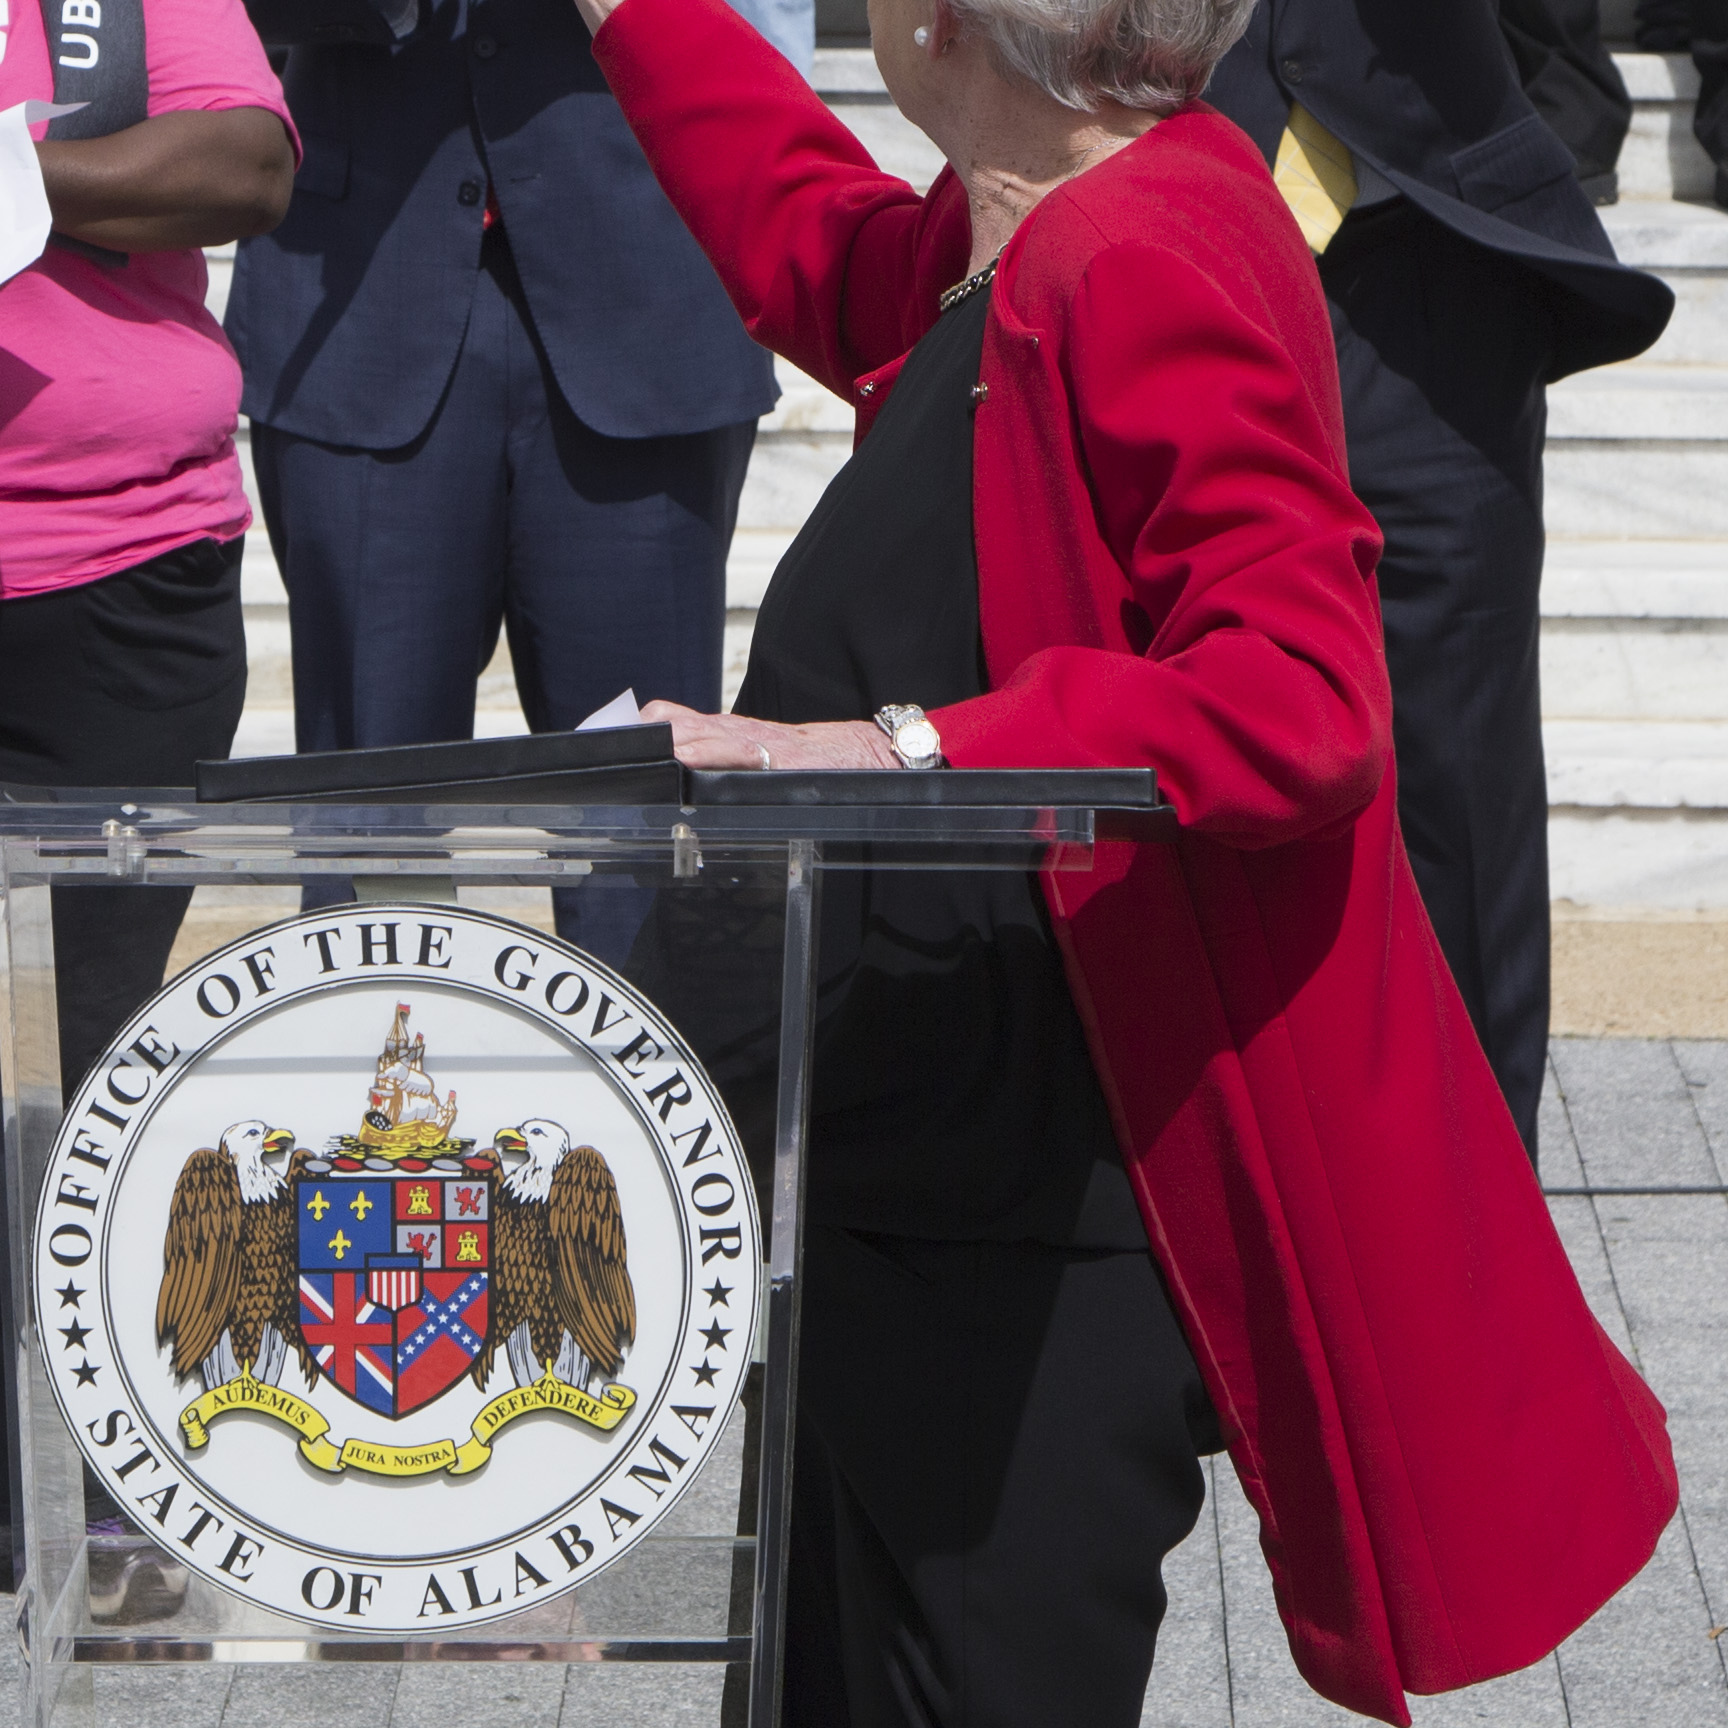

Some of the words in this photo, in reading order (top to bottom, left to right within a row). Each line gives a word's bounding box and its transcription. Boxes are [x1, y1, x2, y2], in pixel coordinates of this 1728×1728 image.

[48, 1024, 182, 1267] OFFICE
[196, 945, 277, 1018] OF
[302, 922, 454, 975] THE
[493, 944, 743, 1268] GOVERNOR
[85, 1409, 266, 1584] STATE
[300, 1566, 383, 1617] OF
[415, 1404, 718, 1619] ALABAMA
[212, 1386, 311, 1427] AUDEMUS
[346, 1445, 387, 1466] JURA
[392, 1447, 452, 1467] NOSTRA
[482, 1388, 604, 1429] DEFENDERE
